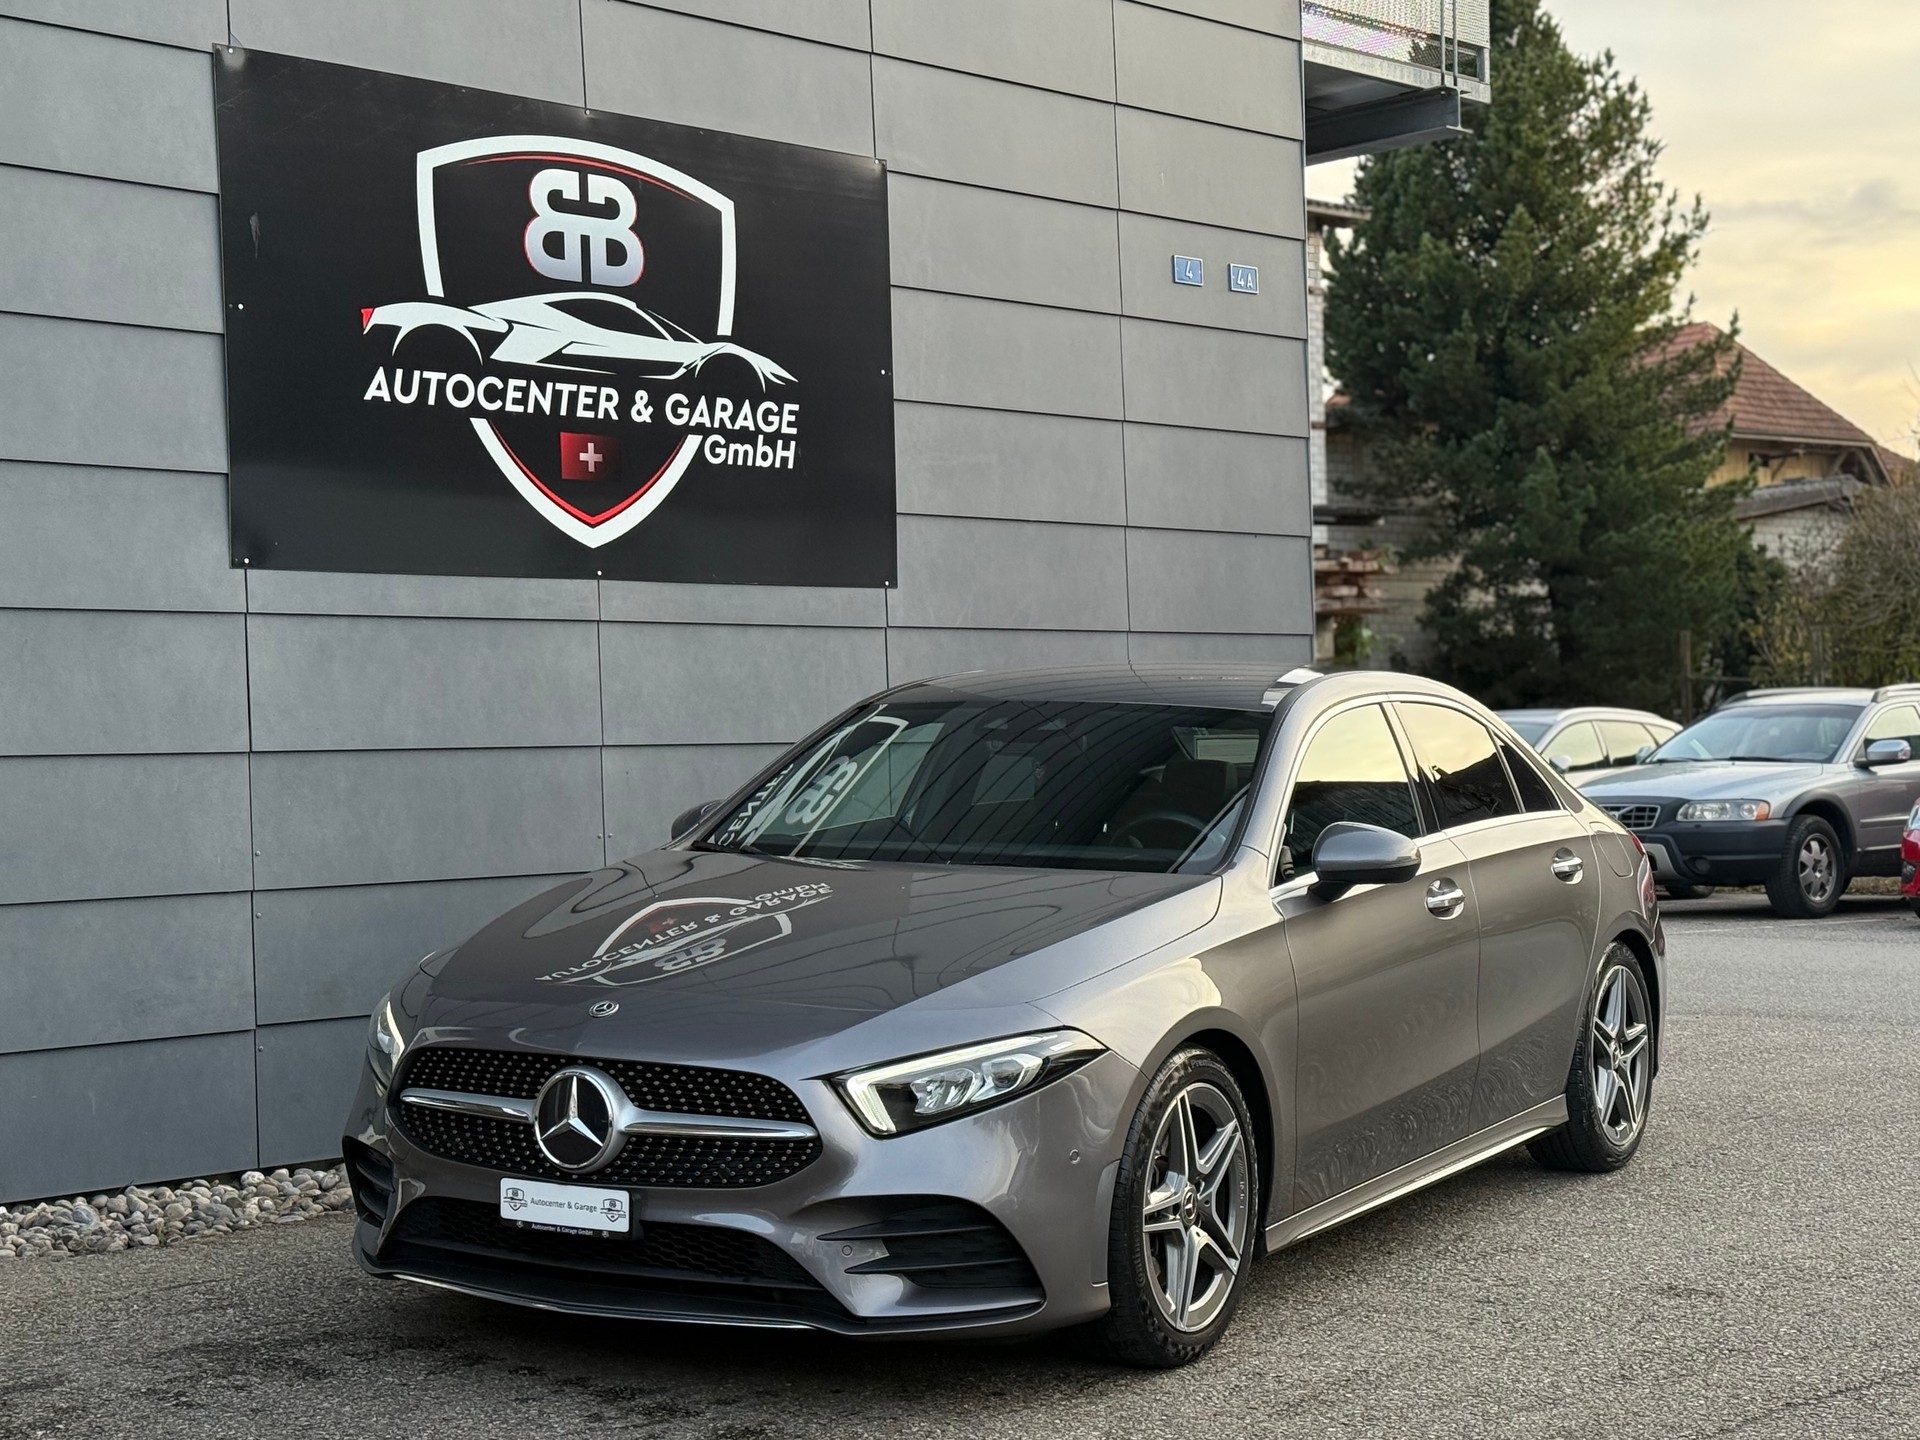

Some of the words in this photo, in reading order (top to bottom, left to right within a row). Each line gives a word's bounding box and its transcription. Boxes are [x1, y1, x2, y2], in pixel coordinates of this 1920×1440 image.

[1185, 260, 1194, 279] 4
[1237, 269, 1254, 288] 4A
[363, 366, 620, 420] AUTOCENTER
[630, 390, 654, 423] &
[665, 393, 800, 434] GARAGE
[703, 435, 797, 469] GmbH
[530, 1197, 566, 1209] Autocenter
[567, 1201, 573, 1209] &
[574, 1202, 598, 1213] Garage
